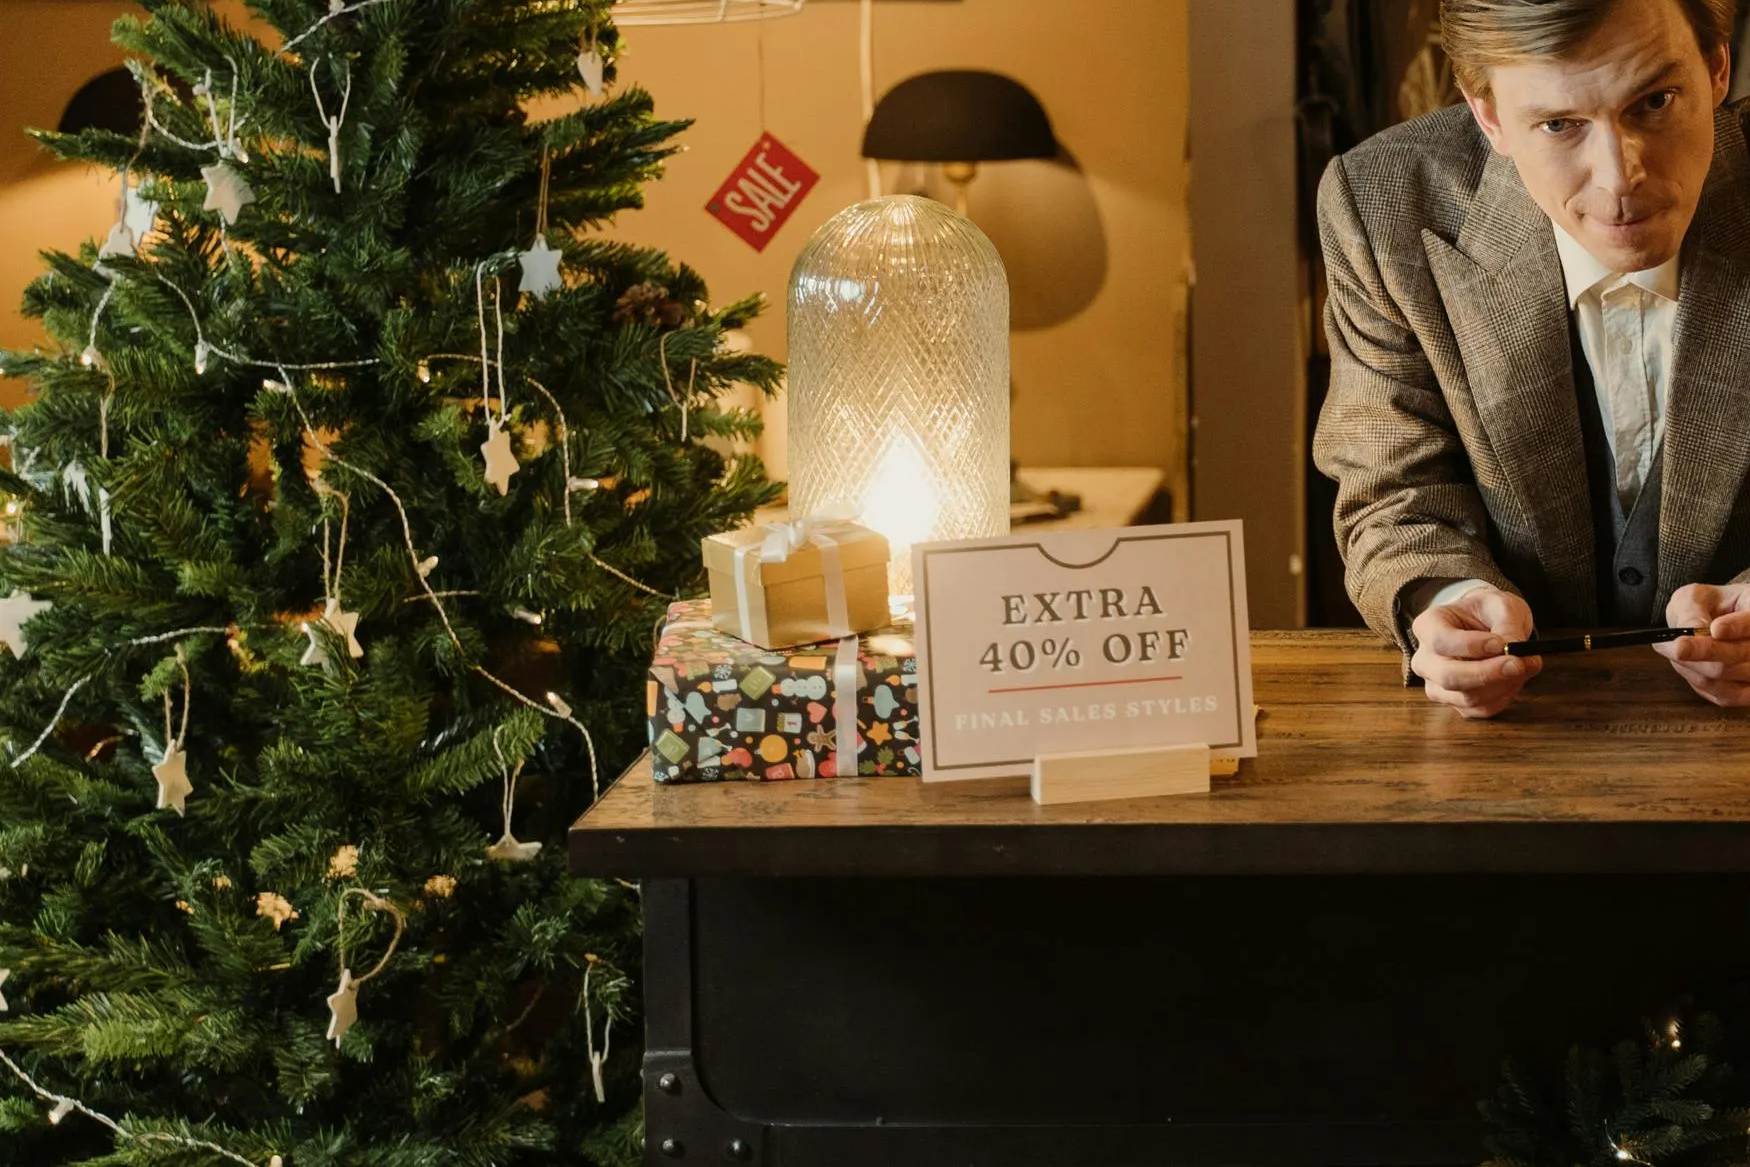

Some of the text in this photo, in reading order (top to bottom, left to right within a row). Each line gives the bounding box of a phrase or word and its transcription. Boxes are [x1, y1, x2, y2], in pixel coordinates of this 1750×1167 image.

[723, 152, 802, 232] SALE
[1001, 585, 1166, 626] EXTRA
[979, 629, 1191, 674] 40% OFF
[955, 695, 1219, 731] FINAL SALES STYLES
